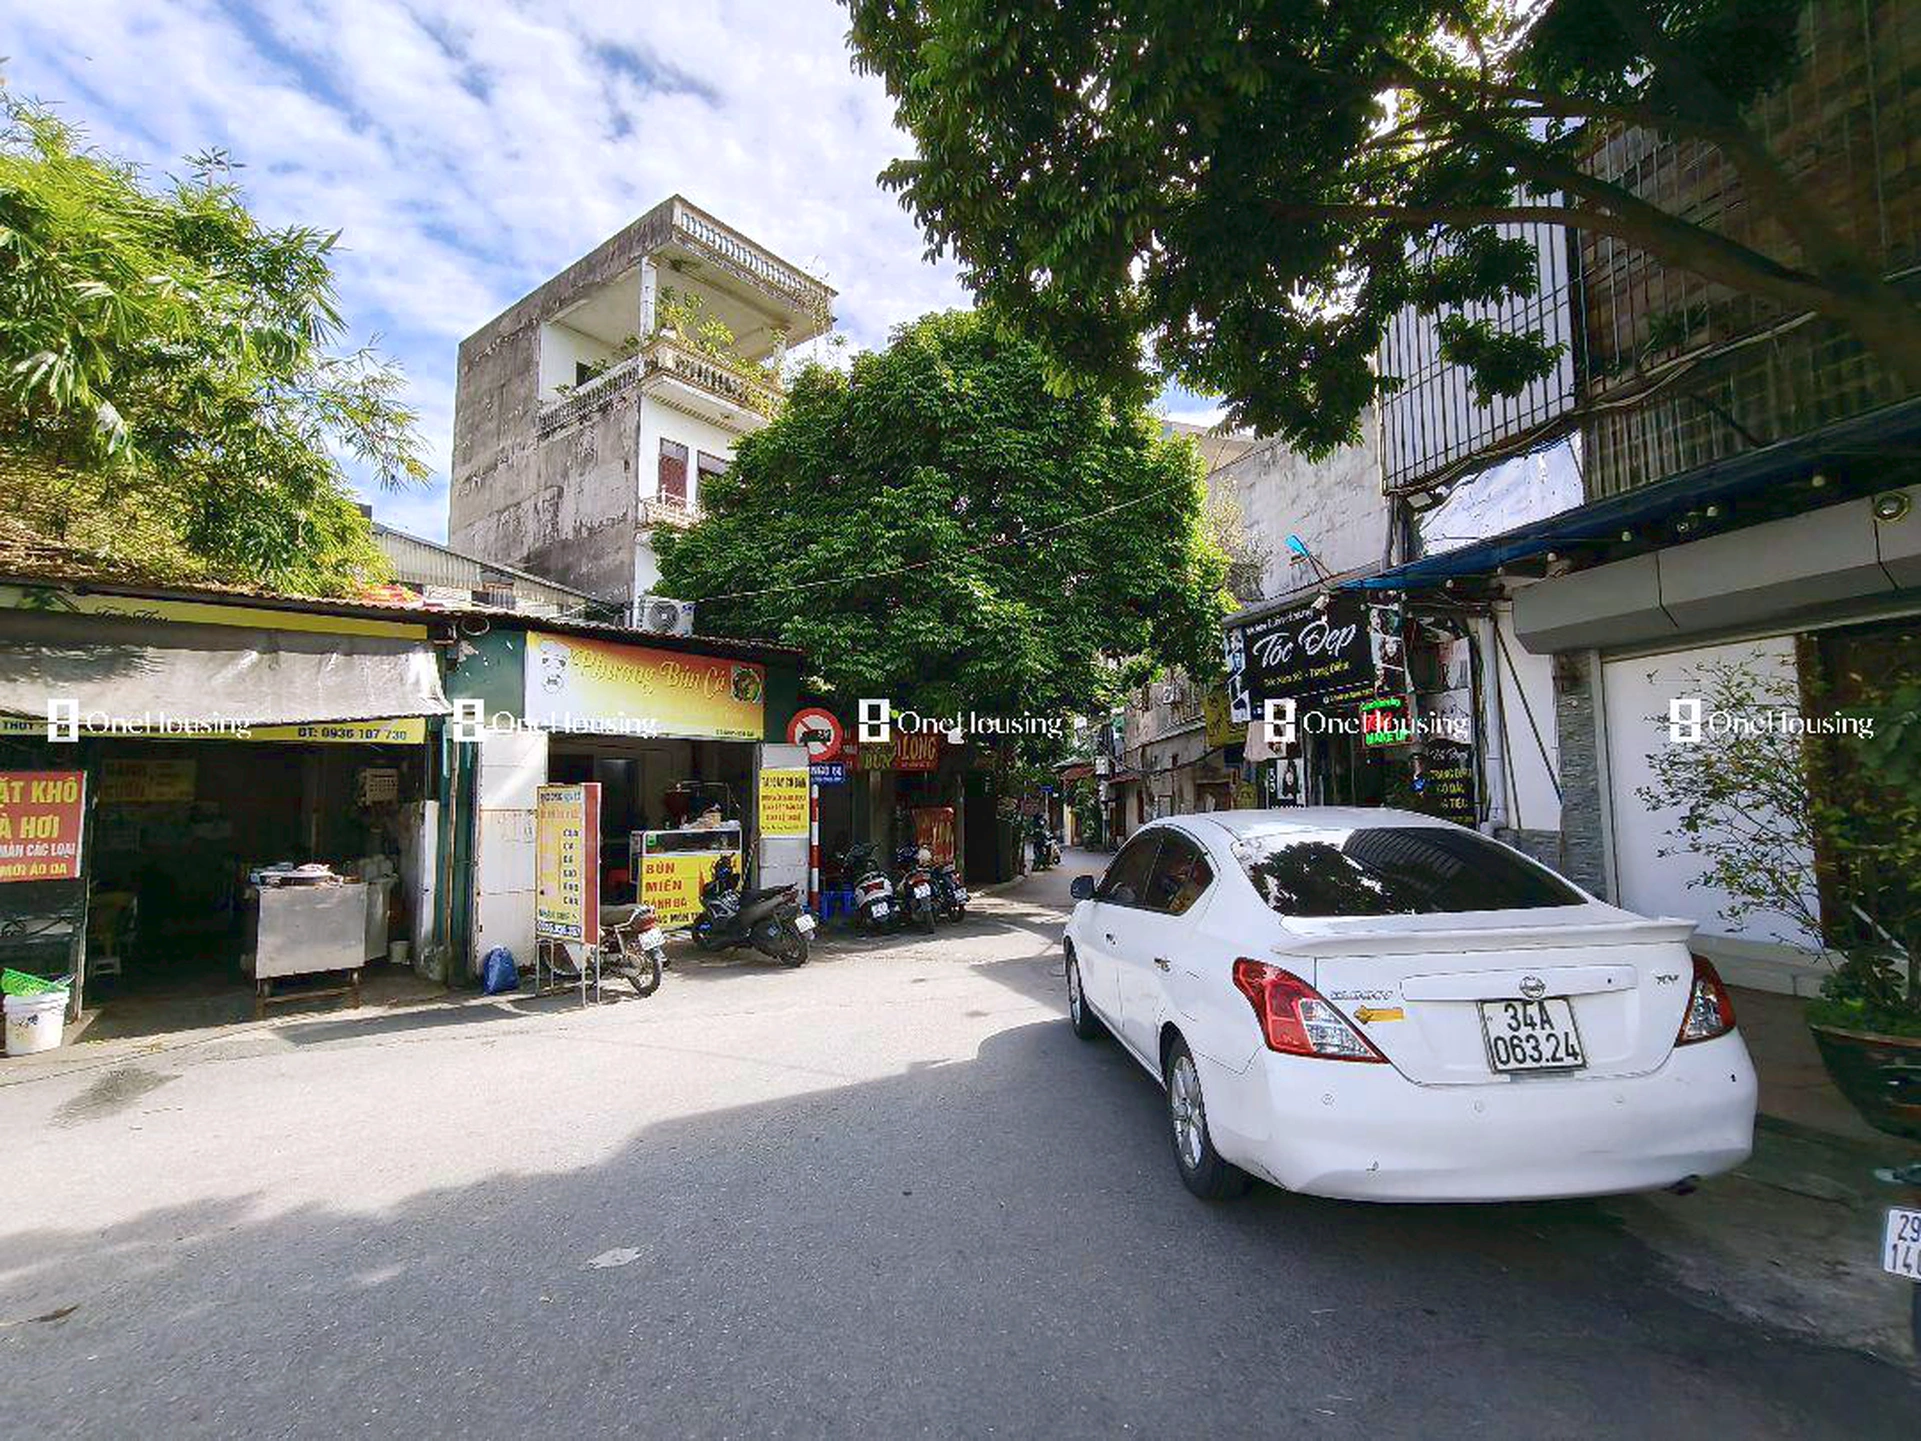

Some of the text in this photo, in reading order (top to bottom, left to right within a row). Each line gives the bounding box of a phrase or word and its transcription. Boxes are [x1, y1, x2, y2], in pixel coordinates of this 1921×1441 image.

[1252, 631, 1294, 668] Tóc
[1298, 619, 1356, 657] Đẹp
[30, 777, 78, 803] KHÔ
[20, 815, 60, 839] HƠI
[26, 841, 49, 857] CÁC
[646, 861, 675, 875] BÚN
[1504, 1000, 1555, 1032] 34A
[1494, 1031, 1580, 1066] 063.24
